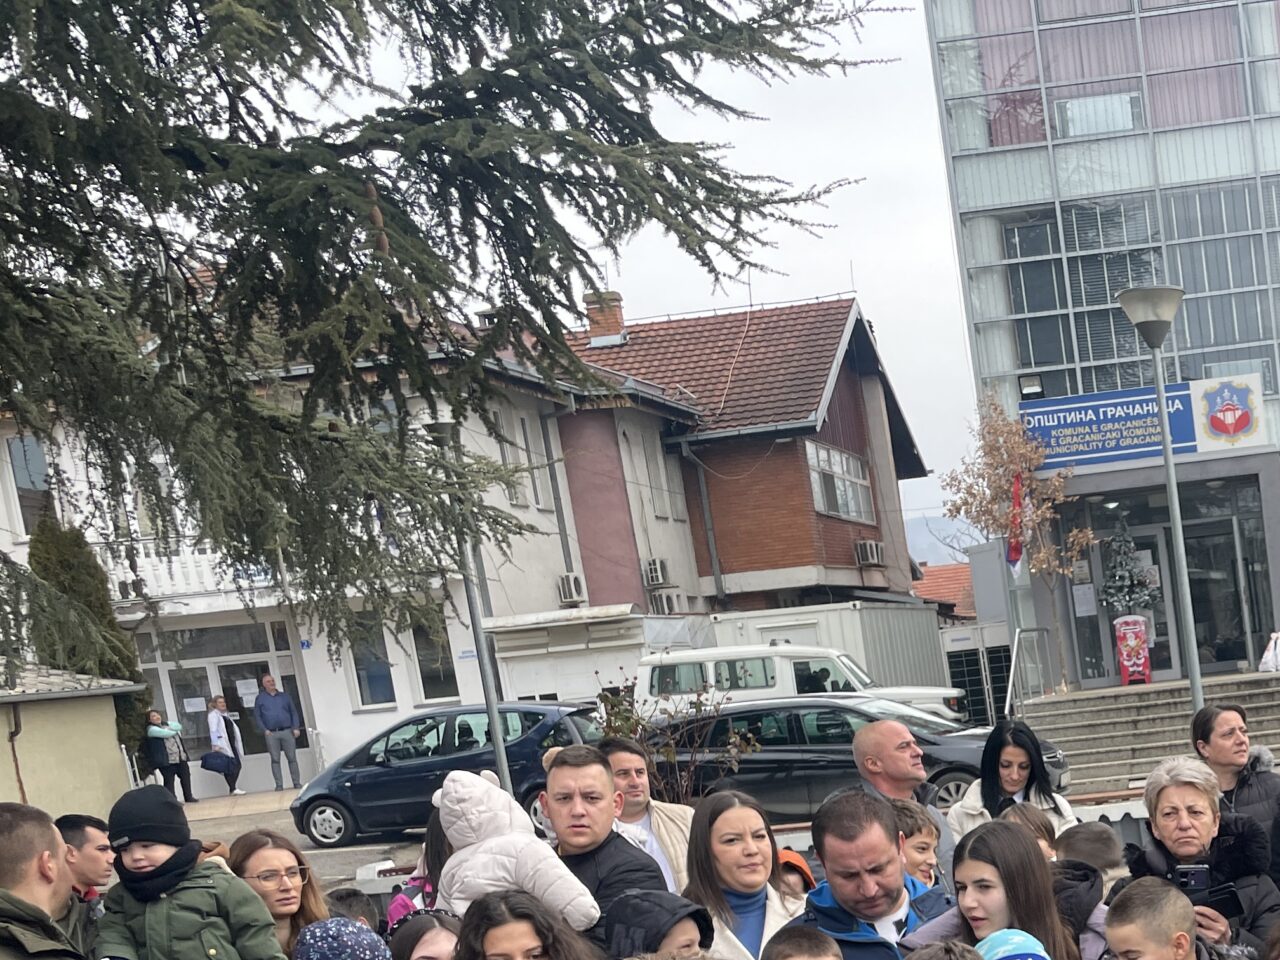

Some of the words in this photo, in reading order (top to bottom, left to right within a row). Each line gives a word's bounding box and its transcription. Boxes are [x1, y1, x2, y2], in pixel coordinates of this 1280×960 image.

[1025, 409, 1096, 428] ОПШТИНА
[1051, 425, 1091, 437] KOMUNA
[1092, 424, 1099, 432] E
[1051, 438, 1057, 446] E
[1122, 426, 1162, 438] KOMUNA
[1044, 441, 1103, 456] MUNICIPALITY
[1105, 439, 1117, 448] OF
[1120, 434, 1164, 447] GRACANI
